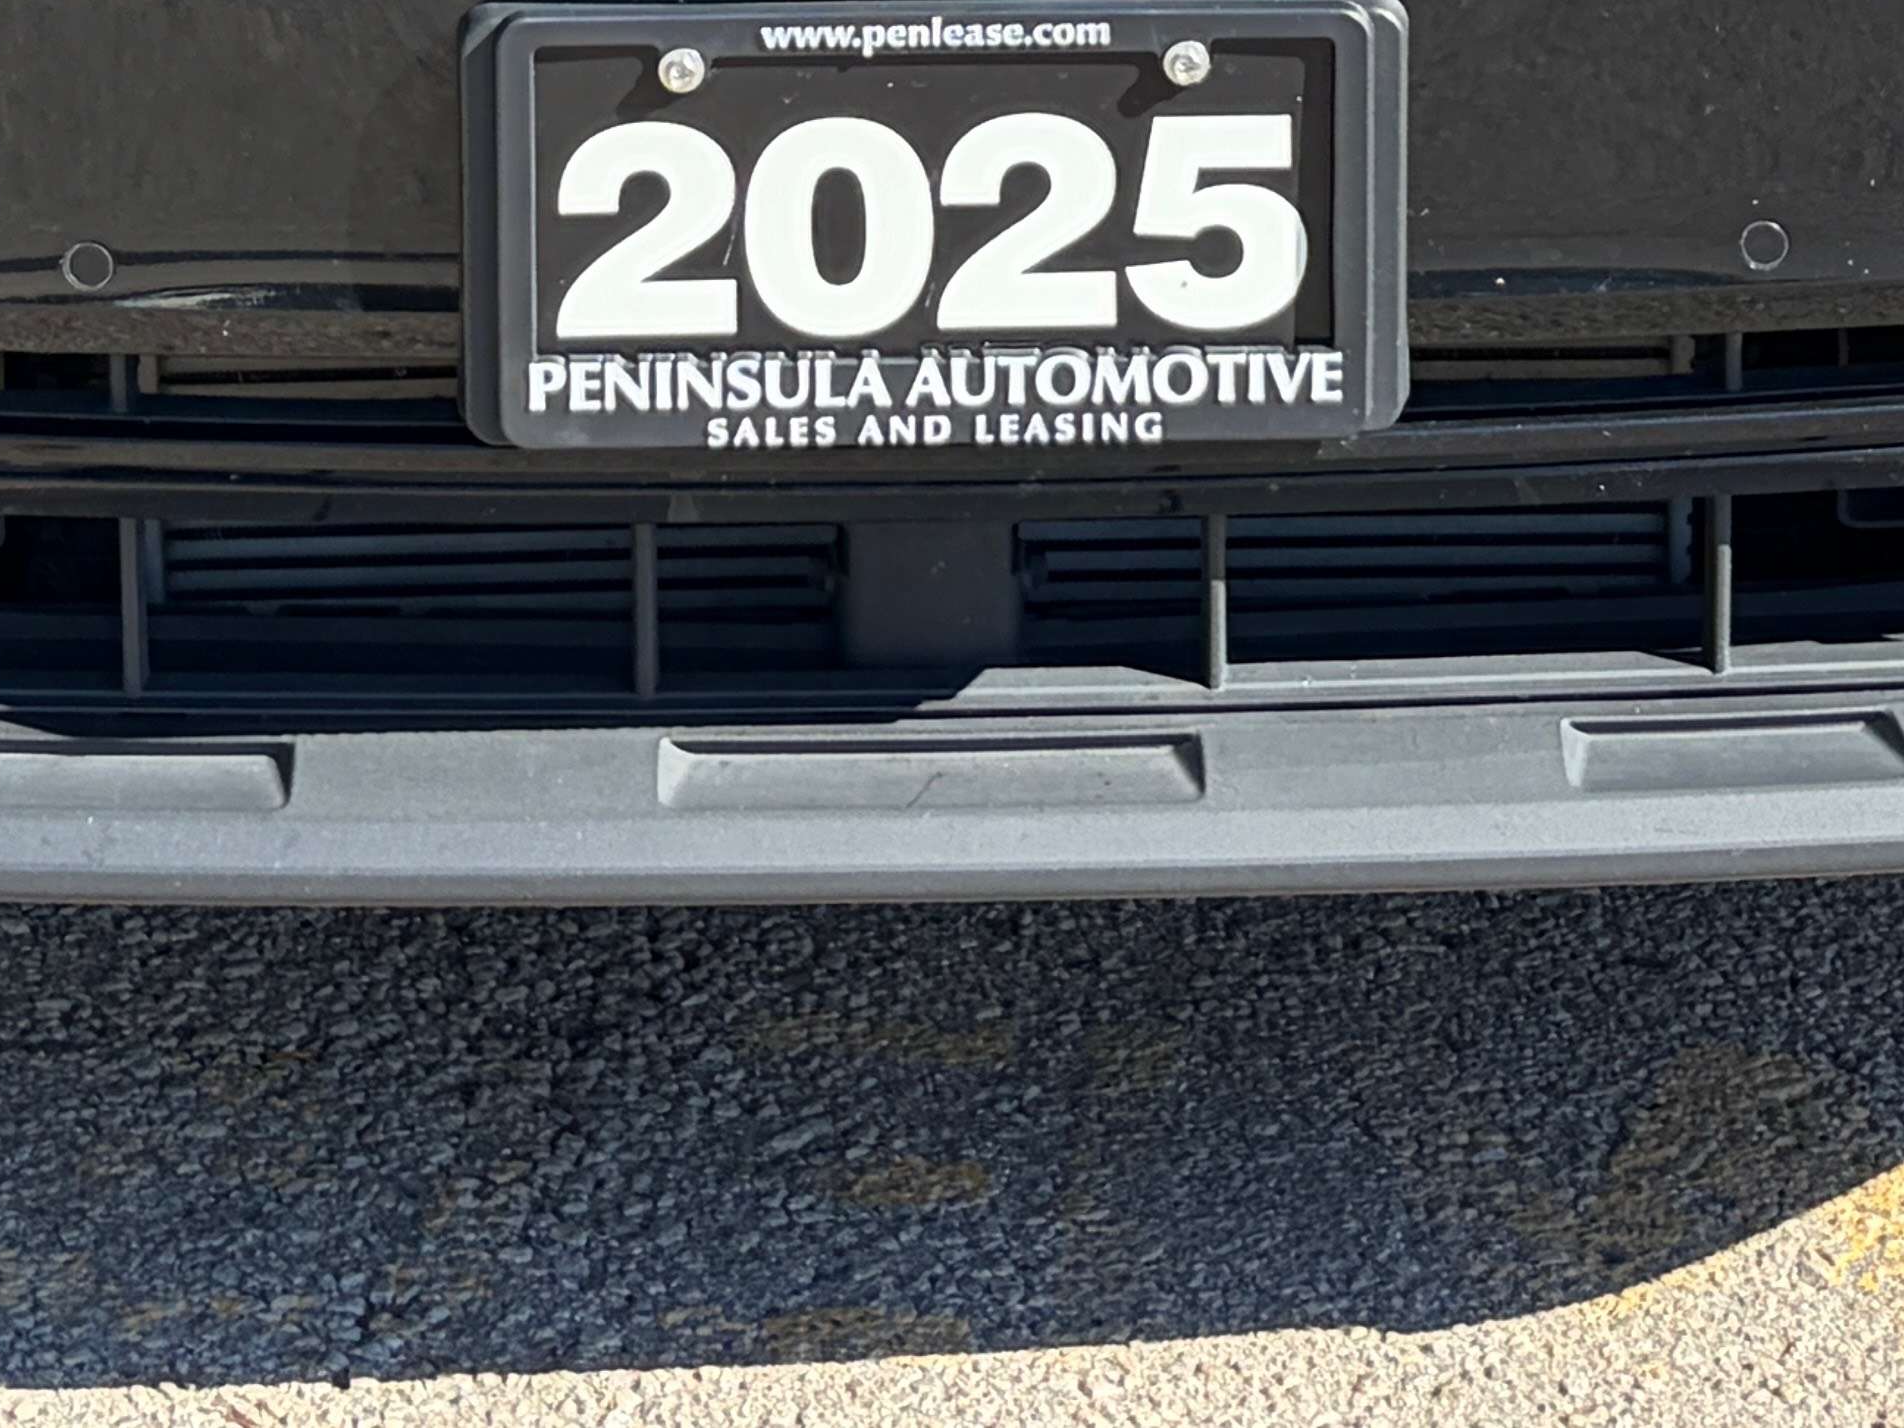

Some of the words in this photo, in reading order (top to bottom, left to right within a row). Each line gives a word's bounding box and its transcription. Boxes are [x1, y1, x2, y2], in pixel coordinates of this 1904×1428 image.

[759, 16, 1112, 56] www.penlease.com
[555, 111, 1309, 340] 2025
[526, 352, 893, 413] PENINSULA
[905, 348, 1345, 410] AUTOMOTIVE
[705, 414, 837, 447] SALES
[856, 414, 949, 446] AND
[974, 412, 1165, 444] LEASING
